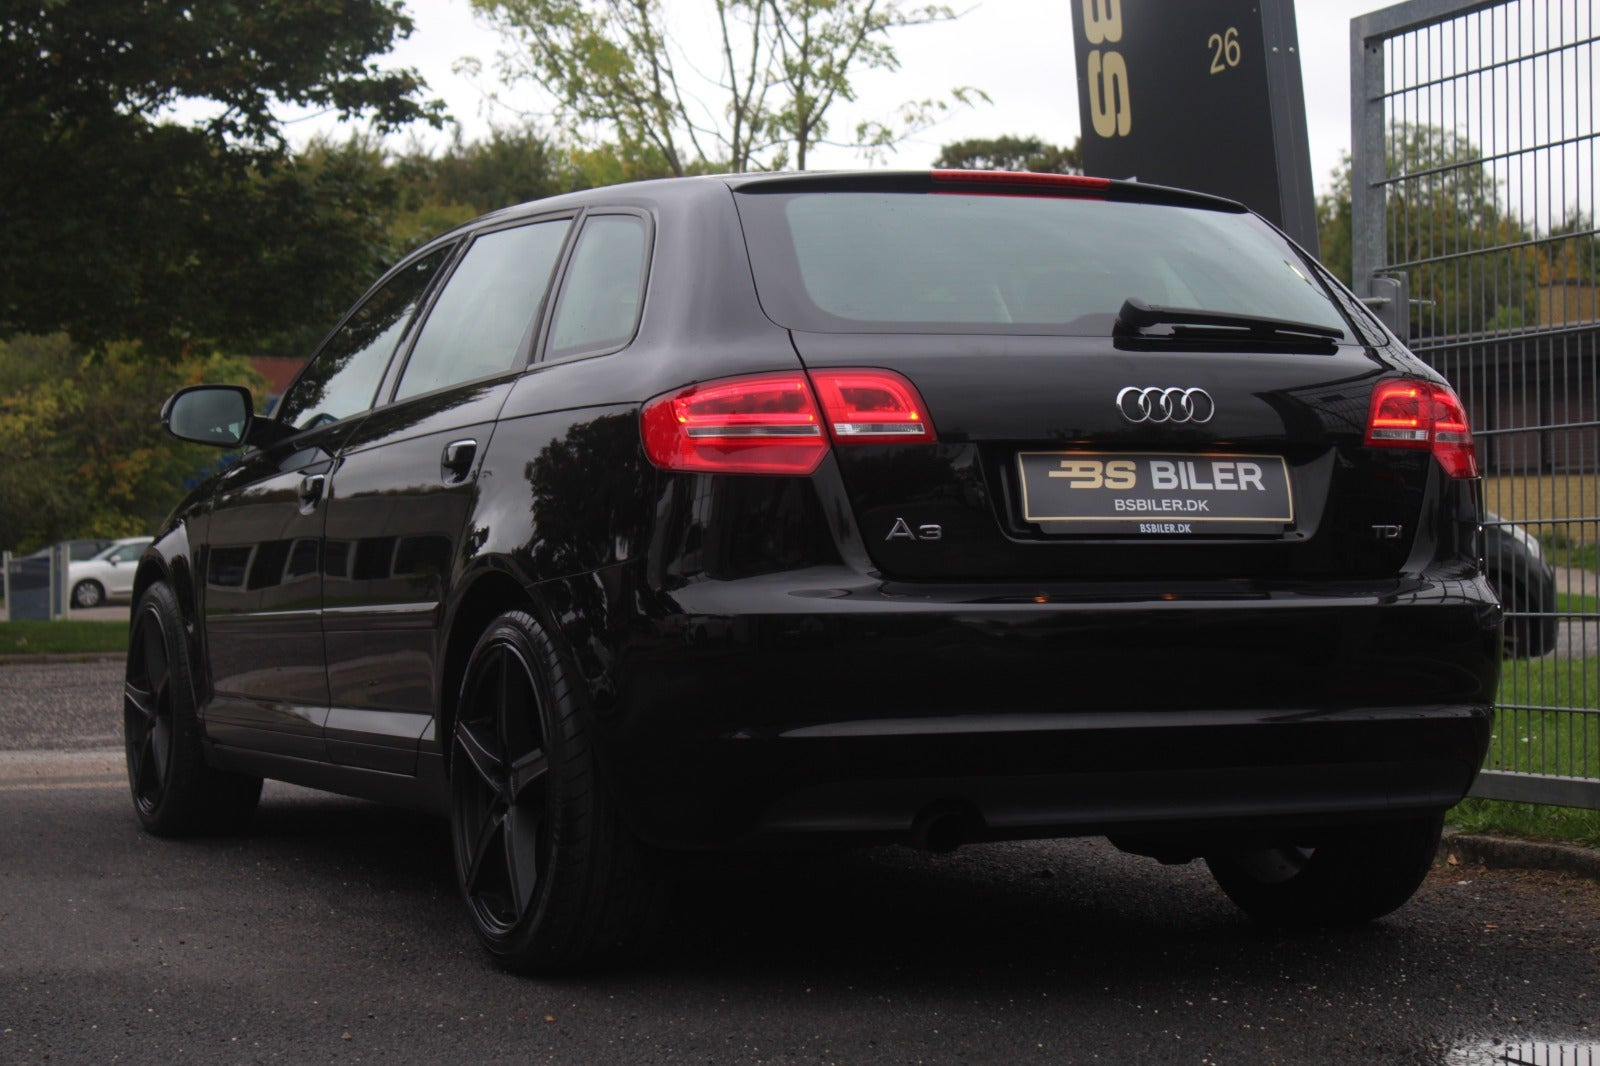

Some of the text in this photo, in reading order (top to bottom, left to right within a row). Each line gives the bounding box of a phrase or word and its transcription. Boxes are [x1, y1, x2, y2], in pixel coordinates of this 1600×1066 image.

[1208, 27, 1241, 75] 26
[1049, 460, 1265, 491] BS BILER
[1115, 499, 1209, 512] BSBILER.DK
[885, 517, 942, 541] A3
[1140, 523, 1192, 534] BSBILER.DK
[1371, 524, 1403, 539] TDI
